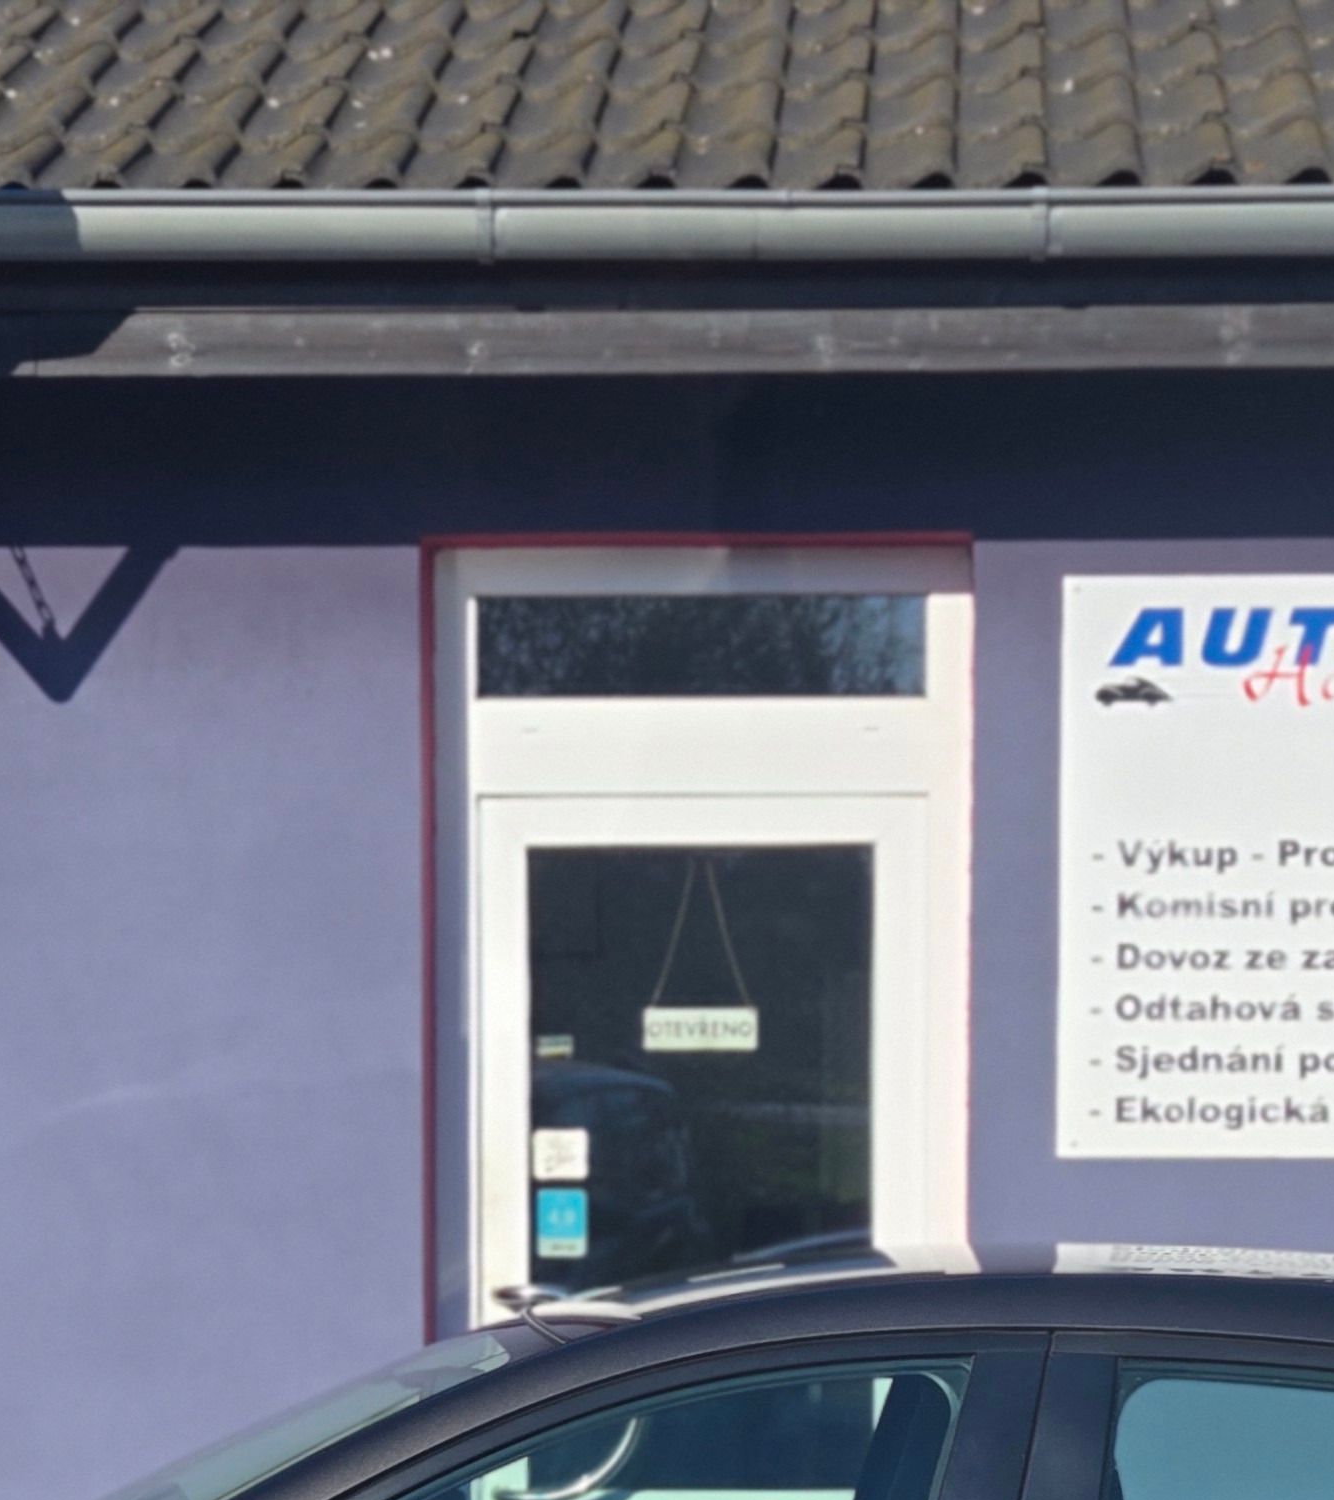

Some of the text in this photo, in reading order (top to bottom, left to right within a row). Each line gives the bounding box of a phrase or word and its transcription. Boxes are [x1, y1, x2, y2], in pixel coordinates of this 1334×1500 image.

[1117, 840, 1239, 874] Výkup
[1117, 892, 1275, 918] Komisní
[1117, 944, 1230, 970] Dovoz
[1245, 950, 1287, 970] ze
[1116, 994, 1301, 1022] Odtahová
[648, 1014, 752, 1038] OTEVŘENO
[1116, 1045, 1284, 1080] Sjednání
[1116, 1097, 1330, 1130] Ekologická
